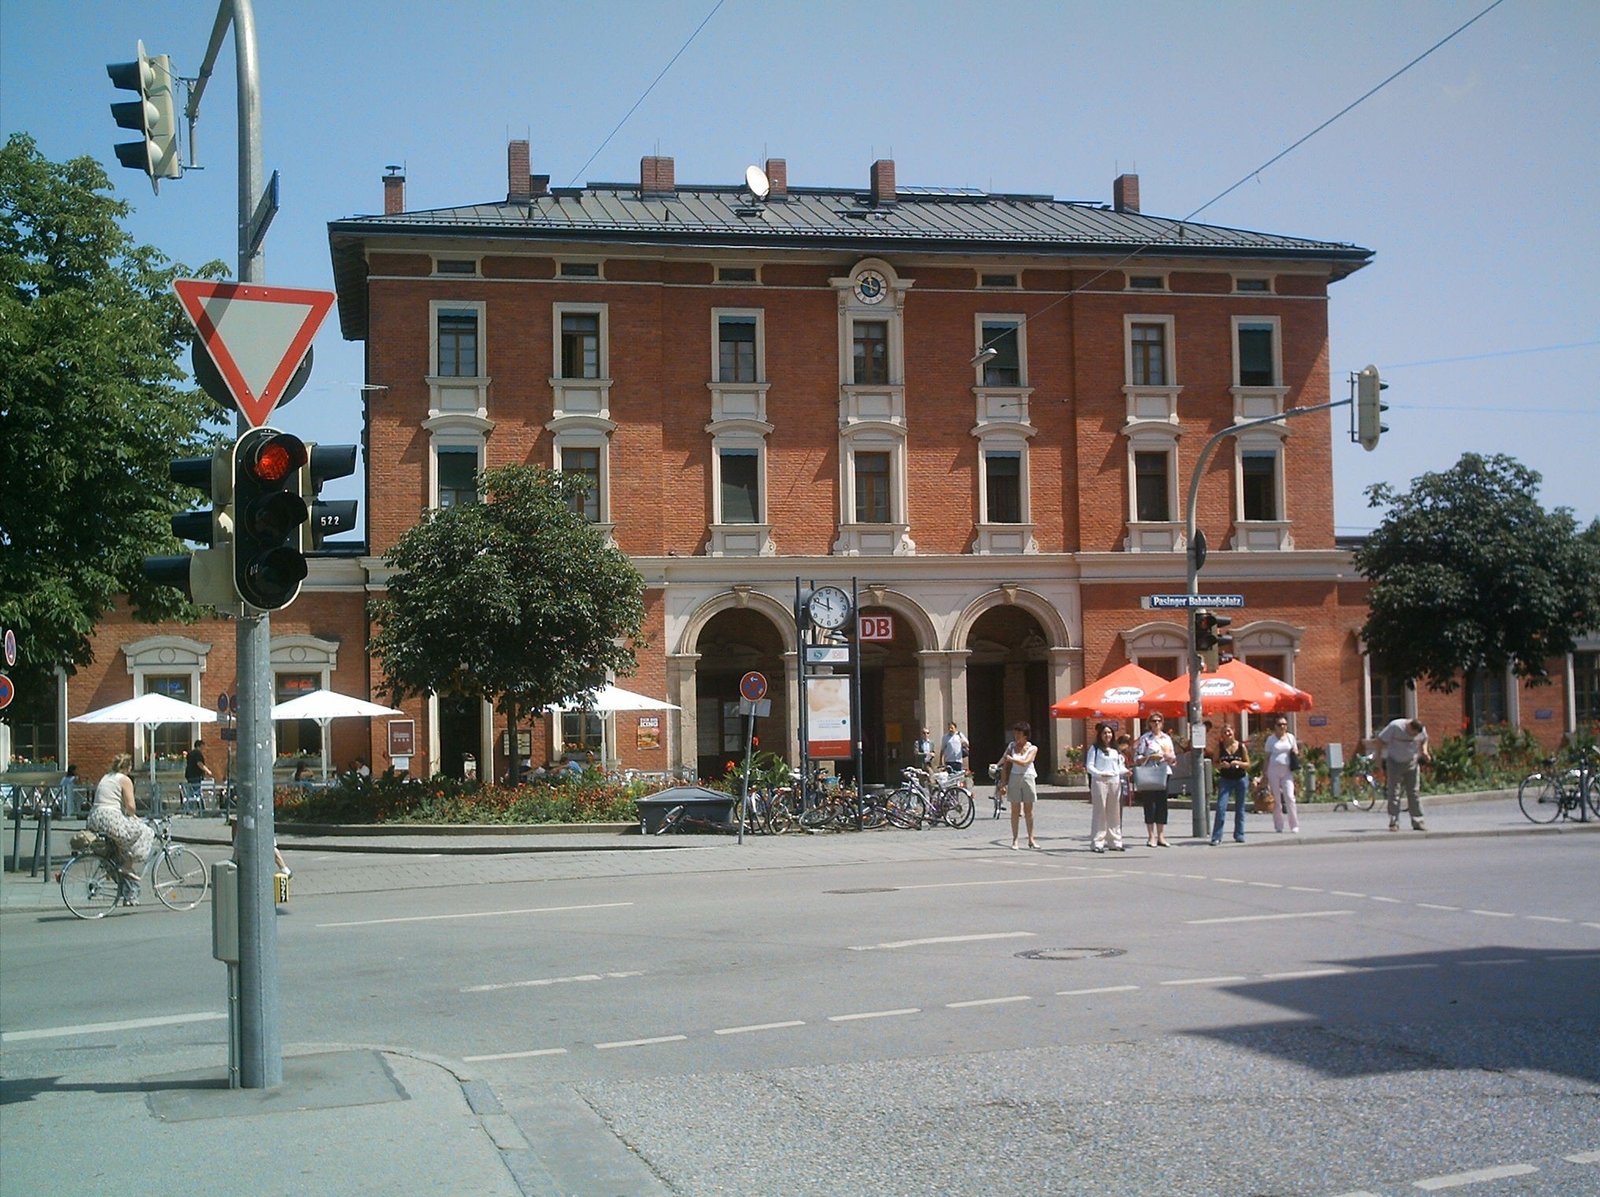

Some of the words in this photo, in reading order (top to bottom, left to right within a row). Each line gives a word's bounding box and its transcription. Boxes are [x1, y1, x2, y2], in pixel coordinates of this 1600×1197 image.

[320, 516, 340, 526] 522
[1153, 597, 1187, 607] Pasinger
[1189, 596, 1241, 607] Bahnhofsplatz
[861, 618, 890, 637] DB
